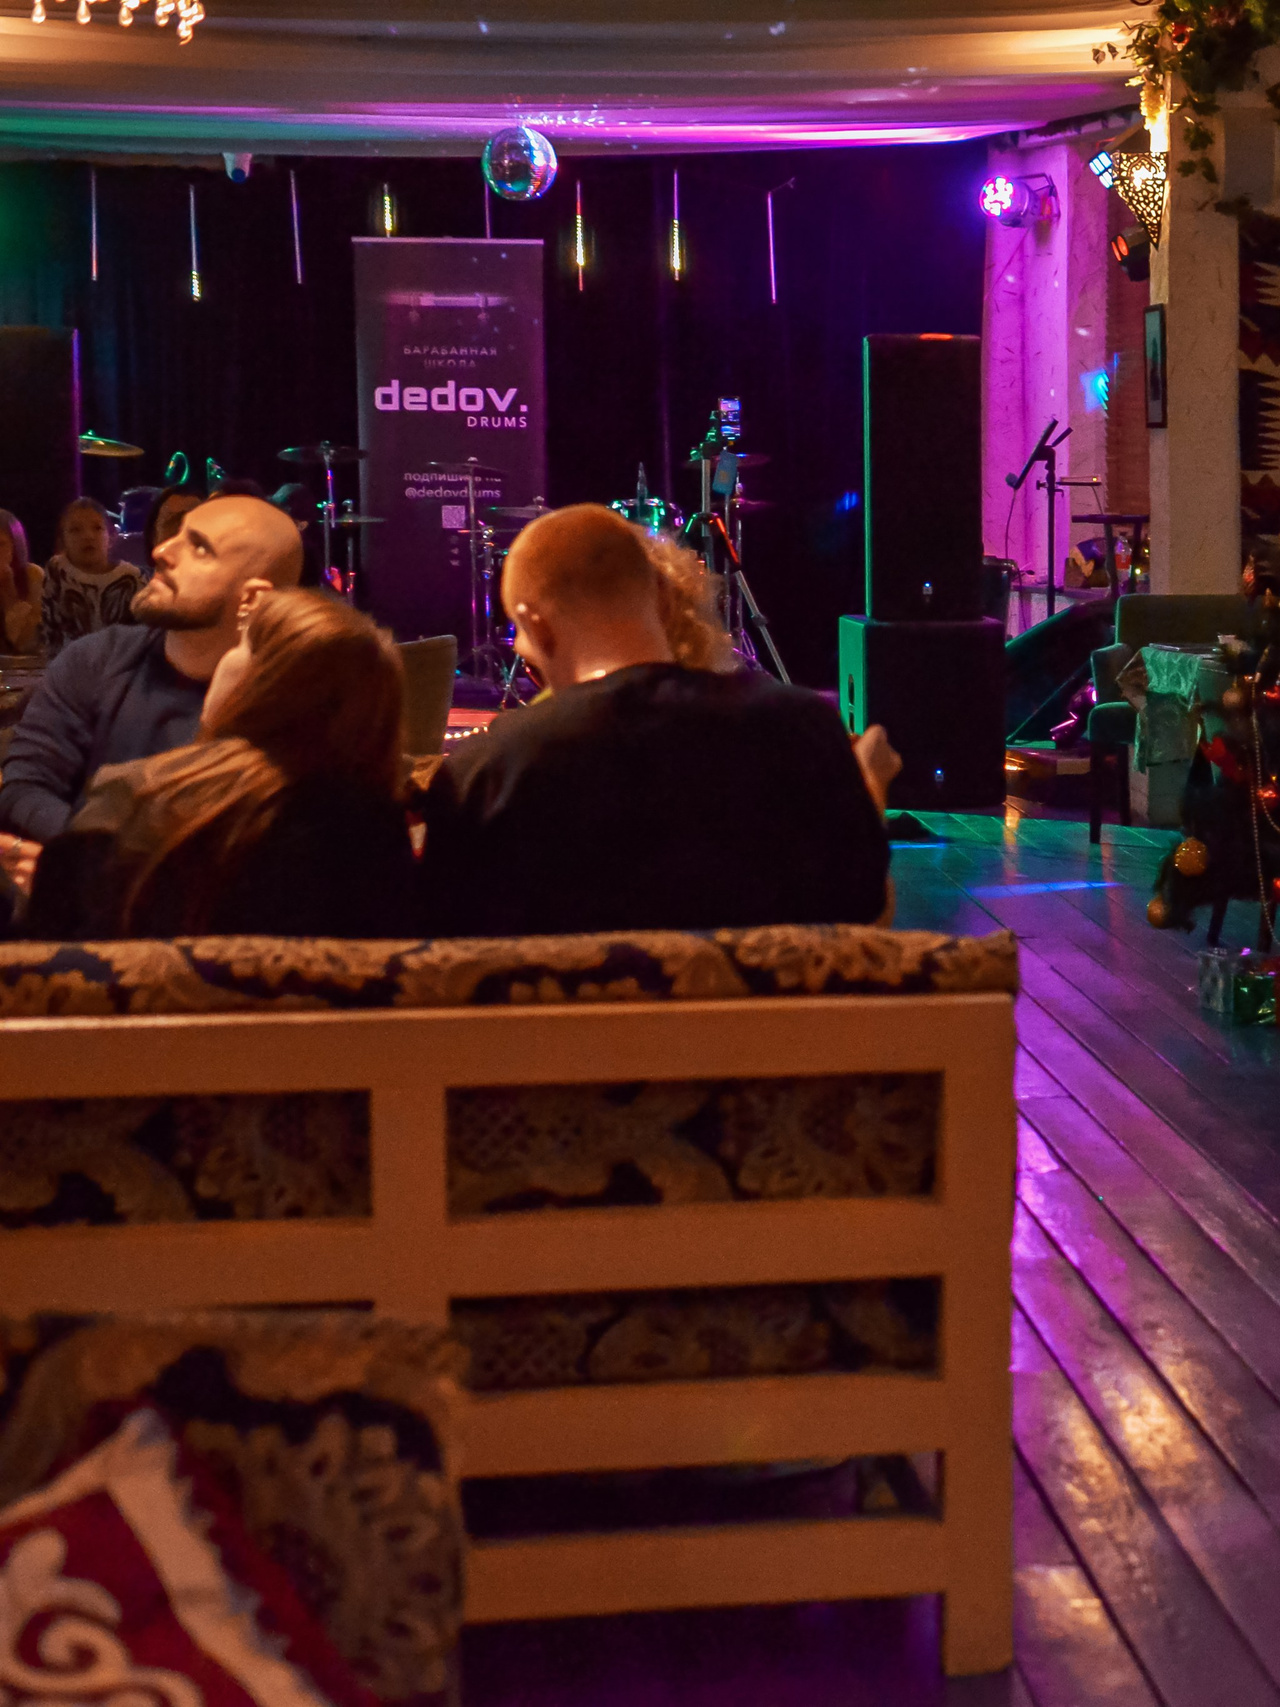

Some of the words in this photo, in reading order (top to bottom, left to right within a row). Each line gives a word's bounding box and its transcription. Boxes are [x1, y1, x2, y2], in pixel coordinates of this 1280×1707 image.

[403, 345, 498, 356] БАРАБАННАЯ
[374, 379, 528, 412] dedov.
[467, 416, 528, 428] DRUMS
[405, 486, 501, 499] @dedovdums
